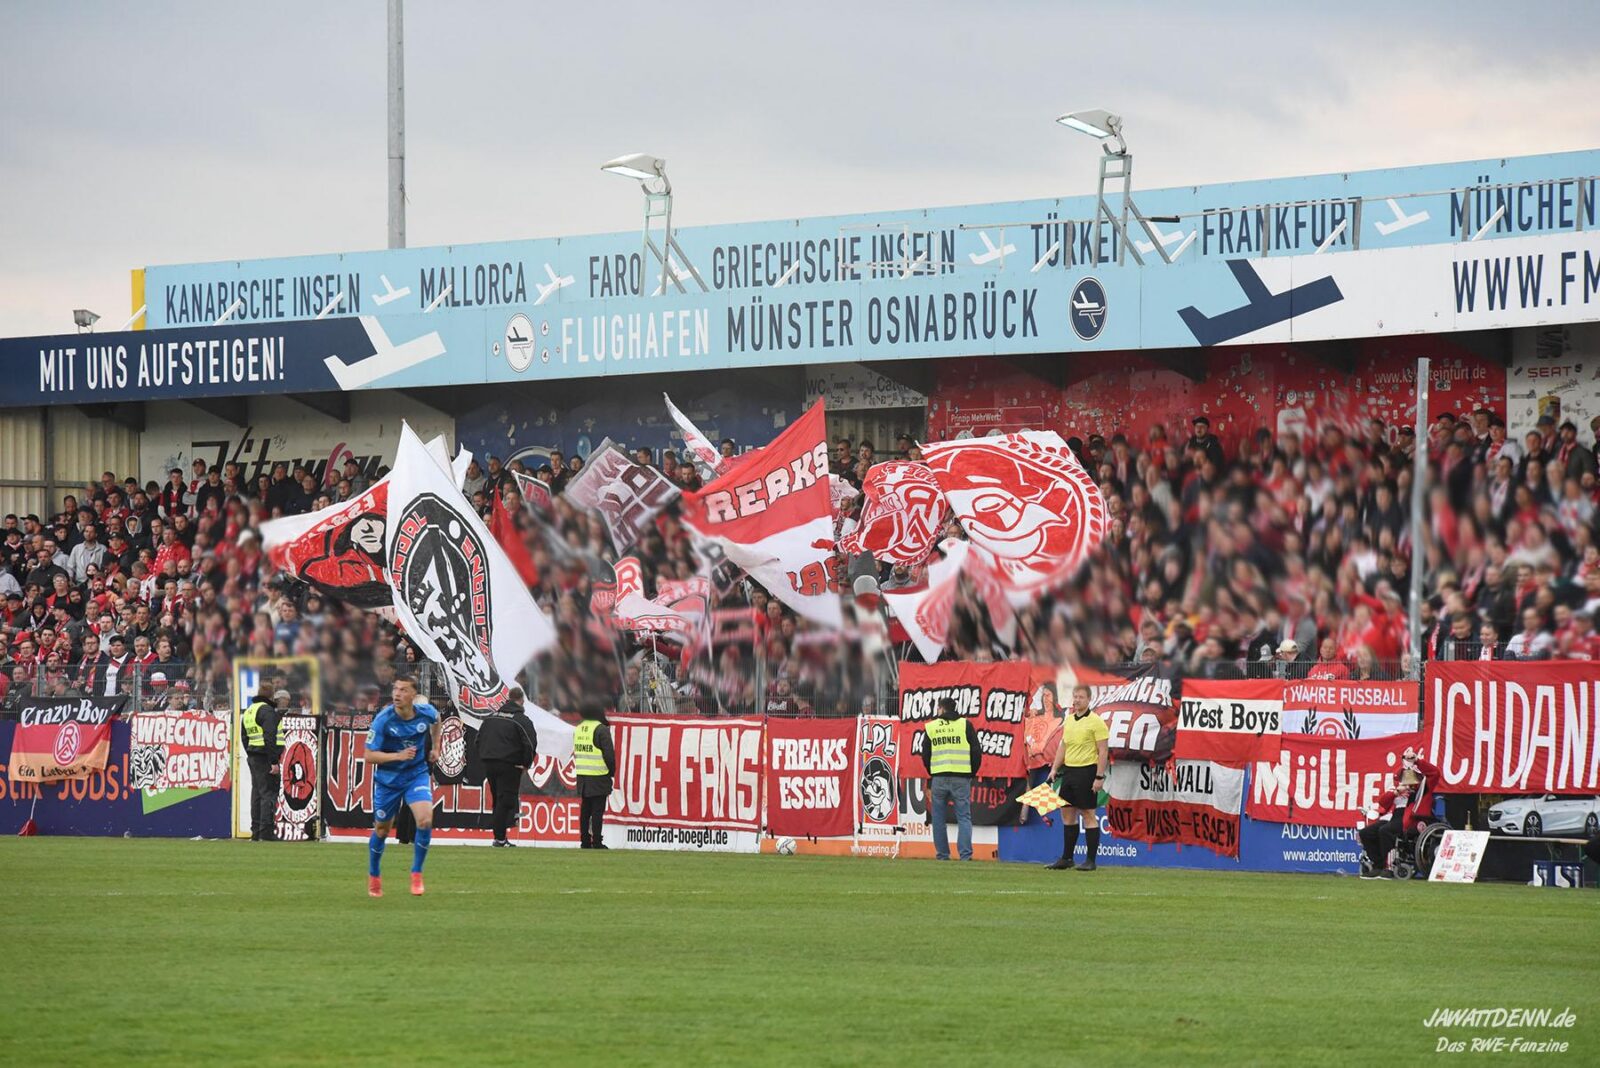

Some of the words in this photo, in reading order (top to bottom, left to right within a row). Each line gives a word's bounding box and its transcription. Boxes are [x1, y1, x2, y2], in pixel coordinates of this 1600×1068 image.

[166, 278, 285, 324] KANARISCHE
[293, 273, 361, 316] INSELN
[420, 261, 527, 308] MALLORCA
[589, 253, 641, 297] FARO
[713, 237, 861, 289] GRIECHISCHE
[872, 230, 955, 278] INSELN
[1031, 213, 1117, 267] TÜRKEI
[1203, 197, 1362, 255] FRANKFURT
[1450, 176, 1594, 236] MÜNCHEN
[562, 308, 709, 363] FLUGHAFEN
[728, 294, 853, 352] MÜNSTER
[868, 281, 1038, 345] OSNABRÜCK
[40, 348, 76, 391] MIT
[86, 345, 128, 389] UNS
[138, 337, 284, 390] AUFSTEIGEN!
[1527, 365, 1572, 378] SEAT
[987, 691, 1026, 722] CREW
[1290, 685, 1336, 704] WAHRE
[1340, 687, 1407, 706] FUSSBALL
[137, 716, 227, 750] WRECKING
[281, 717, 317, 730] ESSENER
[1182, 701, 1223, 728] West
[1230, 703, 1279, 737] Boys
[772, 738, 848, 770] FREAKS
[861, 722, 896, 757] LPL
[932, 735, 961, 746] ORDNER
[167, 752, 217, 782] CREW
[680, 727, 762, 821] FANS
[779, 776, 841, 809] ESSEN
[627, 827, 728, 848] motorrad-boegel.de
